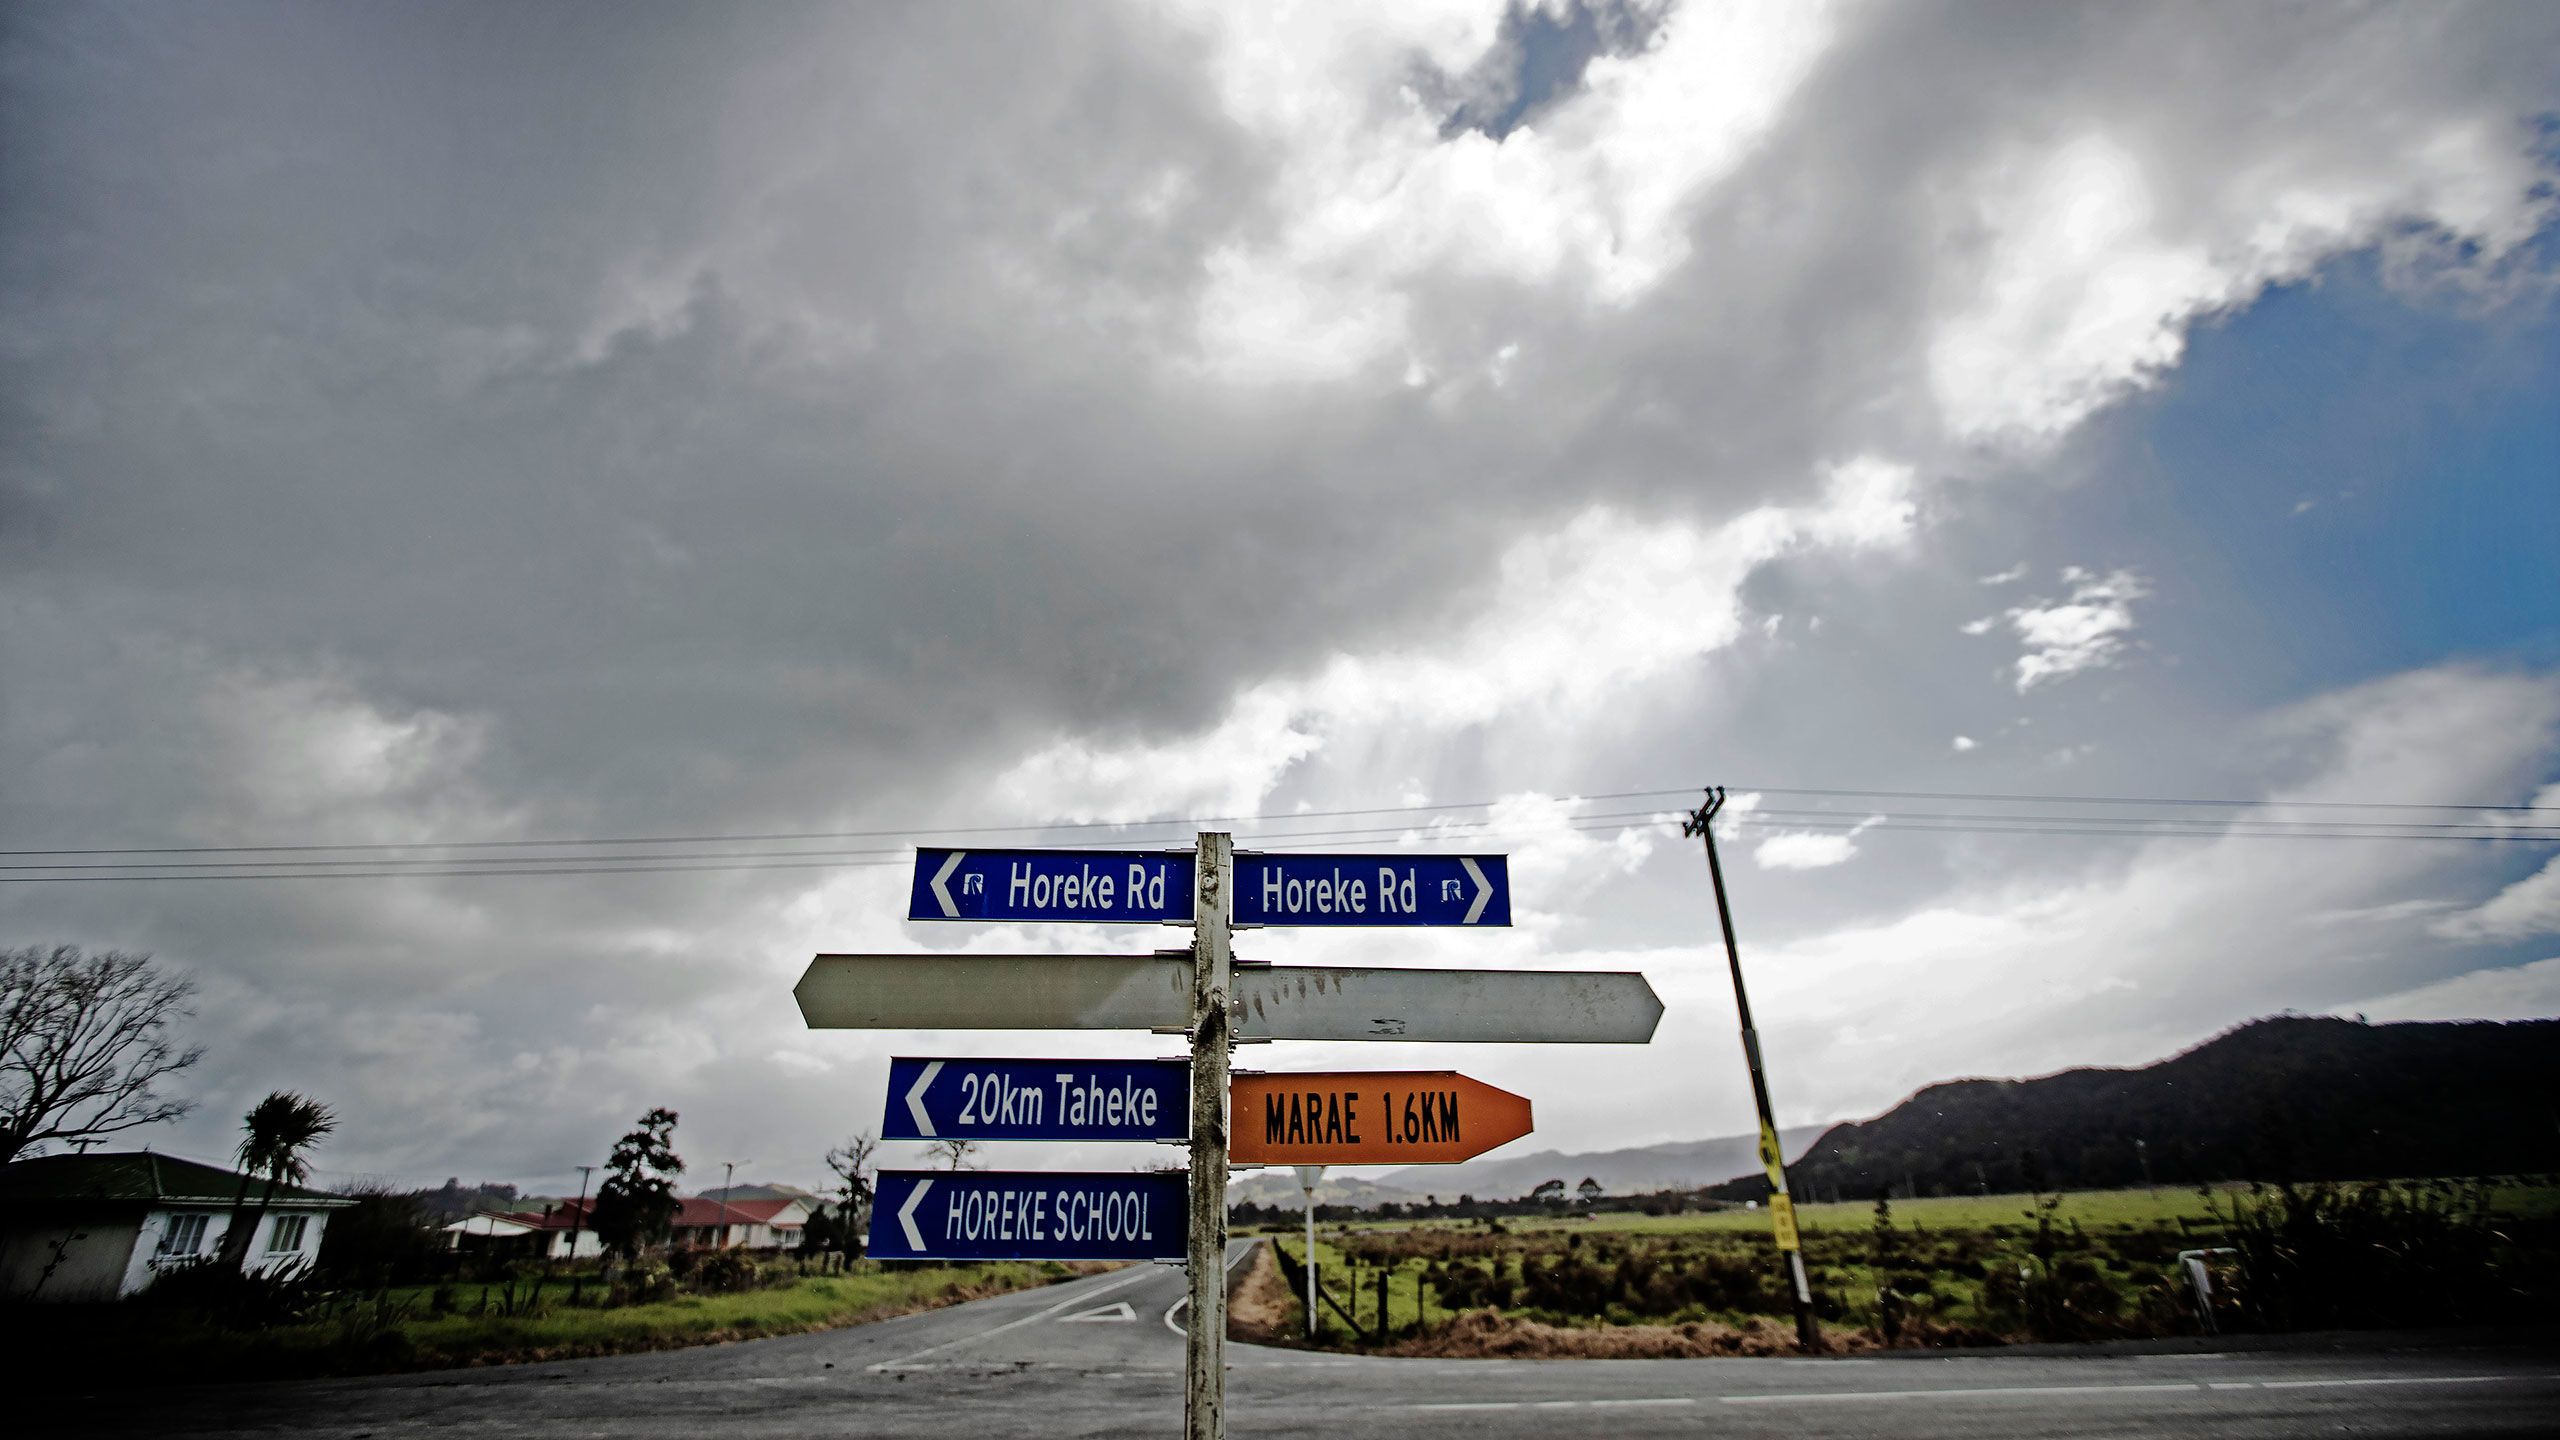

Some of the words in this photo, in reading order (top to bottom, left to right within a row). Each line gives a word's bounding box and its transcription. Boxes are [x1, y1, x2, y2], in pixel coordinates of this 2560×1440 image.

[1008, 862, 1115, 910] Horeke
[1127, 863, 1166, 910] Rd
[1263, 866, 1367, 914] Horeke
[1379, 867, 1417, 914] Rd
[958, 1072, 1044, 1125] 20km
[1055, 1073, 1158, 1126] Taheke
[1265, 1092, 1361, 1145] MARAE
[1383, 1091, 1461, 1145] 1.6KM
[946, 1190, 1047, 1241] HOREKE
[1053, 1190, 1152, 1242] SCHOOL
